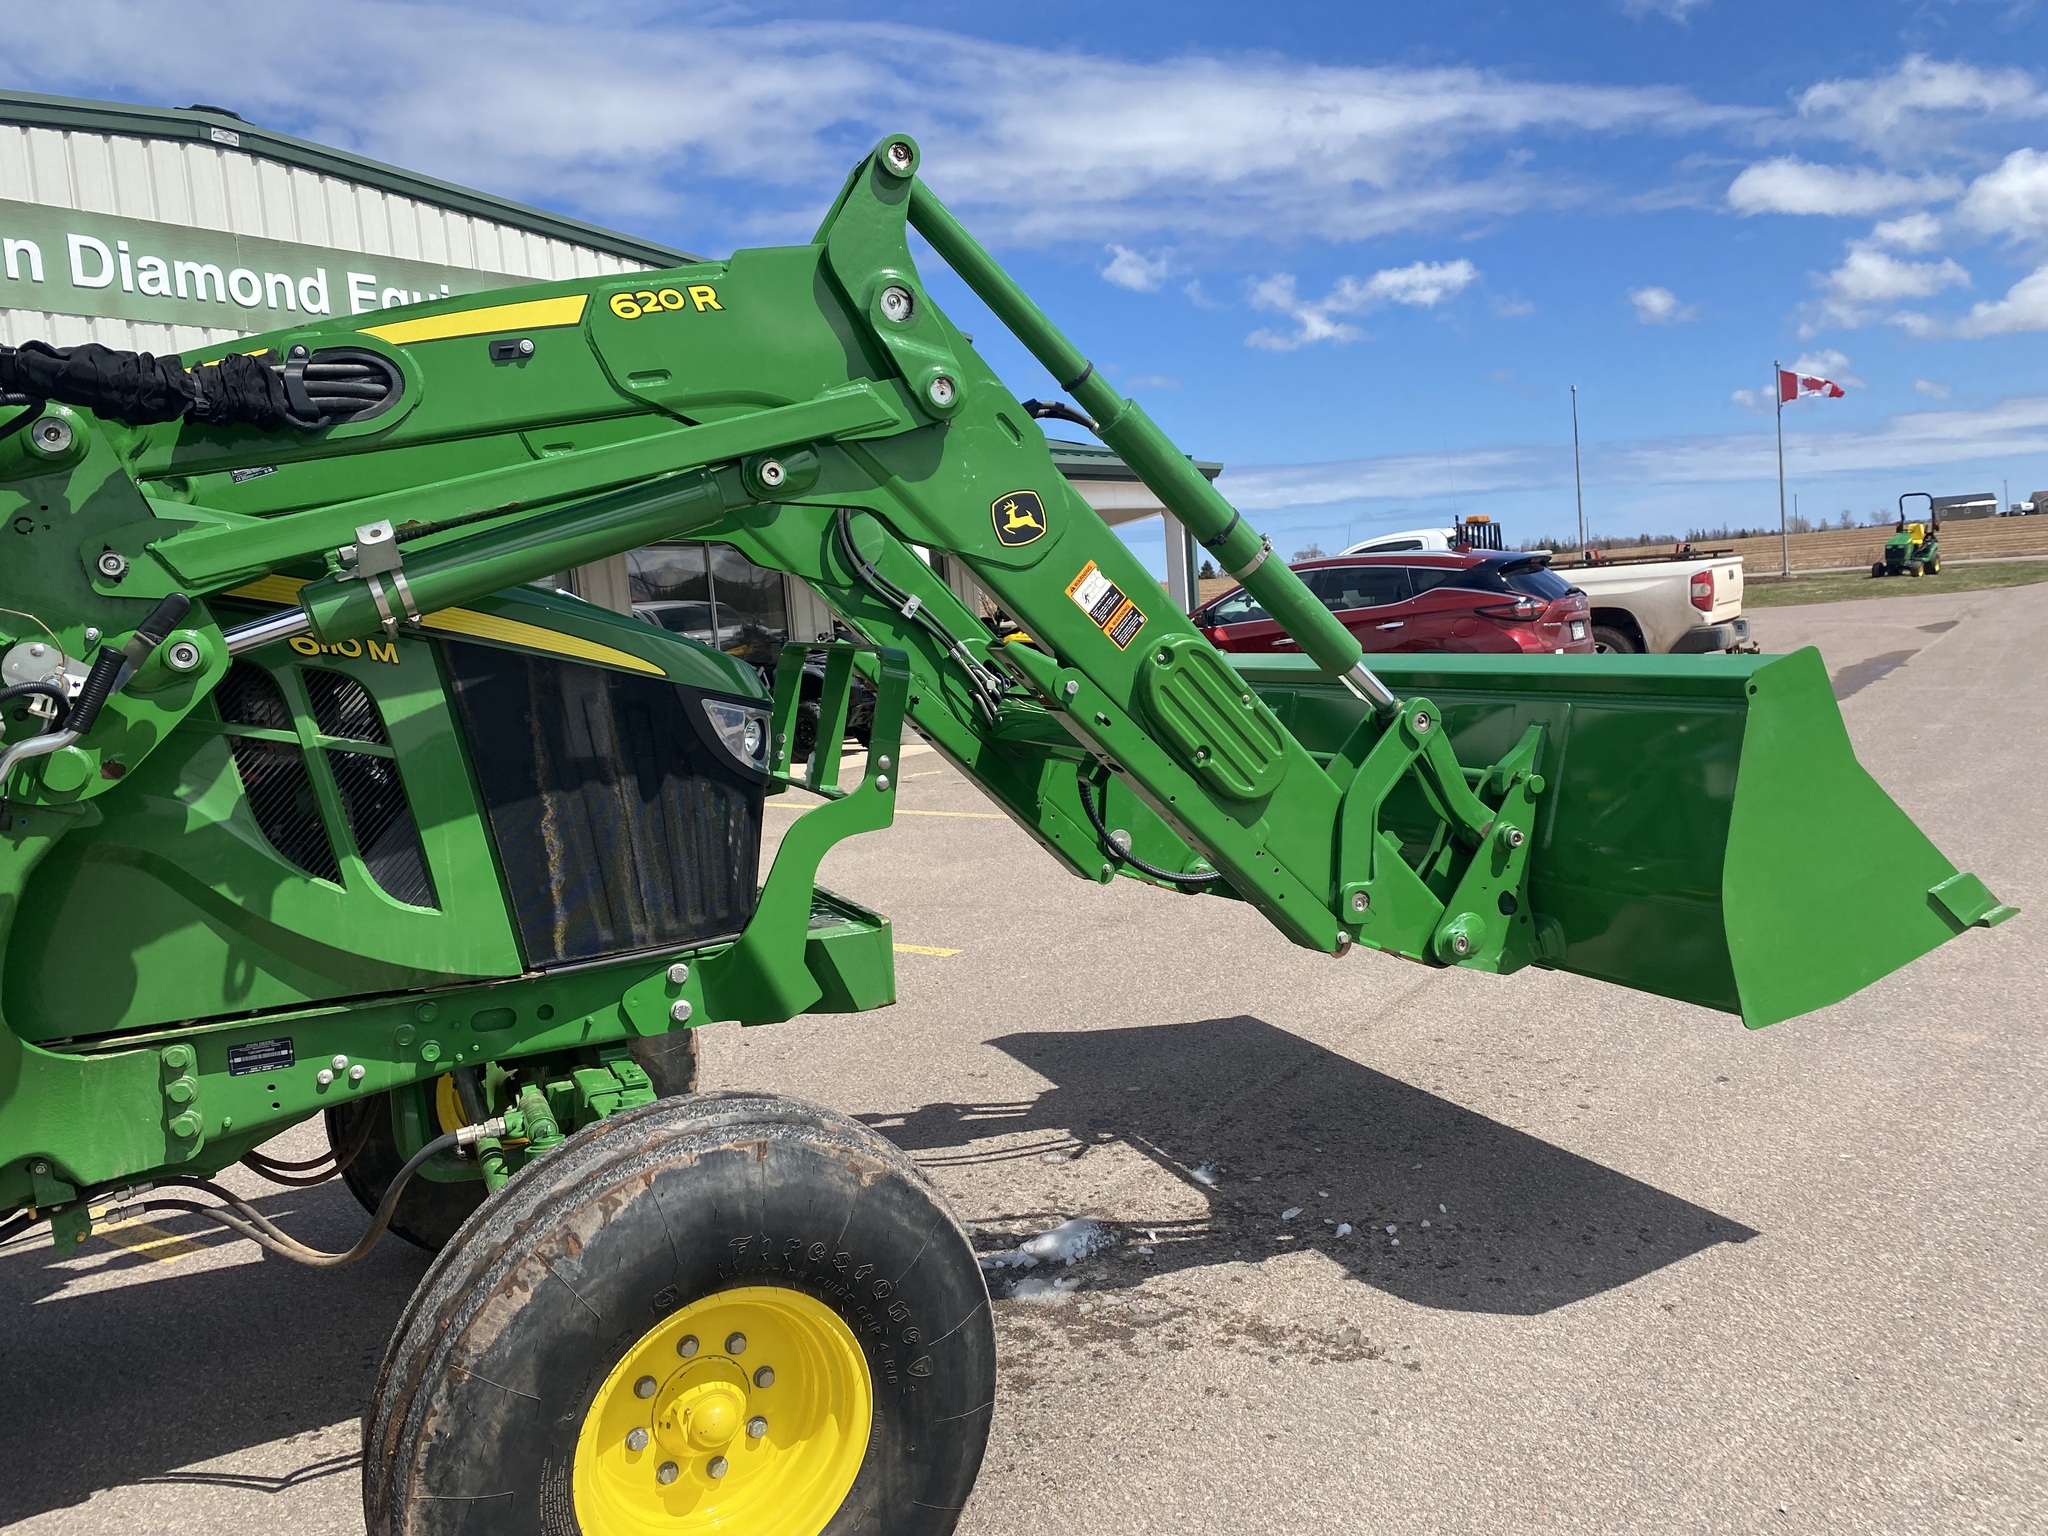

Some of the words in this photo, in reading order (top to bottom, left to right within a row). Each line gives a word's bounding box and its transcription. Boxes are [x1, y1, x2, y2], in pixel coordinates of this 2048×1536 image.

[66, 232, 331, 315] Diamond
[347, 271, 450, 315] Eq
[609, 288, 685, 320] 620
[686, 284, 726, 312] R
[366, 639, 400, 664] M
[857, 1305, 882, 1335] GRIP
[883, 1359, 898, 1385] RIB
